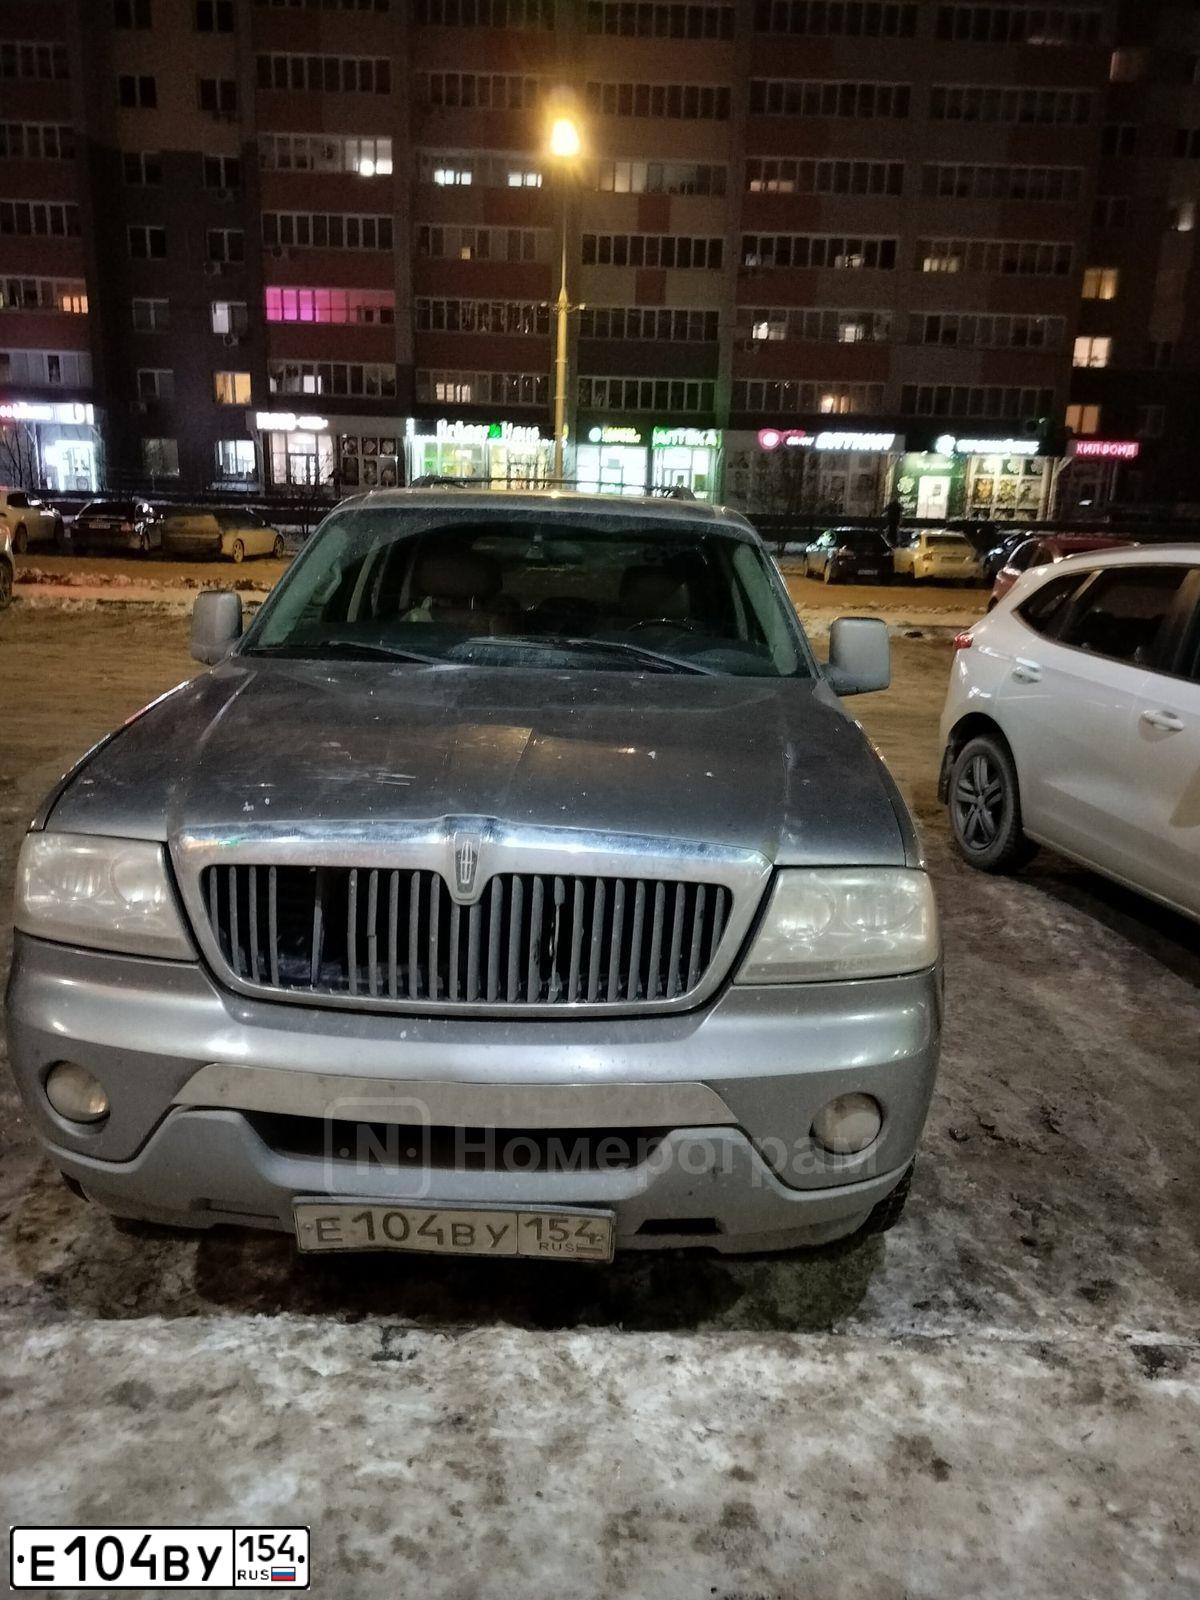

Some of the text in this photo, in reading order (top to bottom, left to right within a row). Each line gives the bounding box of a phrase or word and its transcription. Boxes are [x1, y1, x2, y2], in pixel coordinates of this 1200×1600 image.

[315, 1211, 597, 1249] Е104ВУ 154
[539, 1242, 576, 1252] RUS
